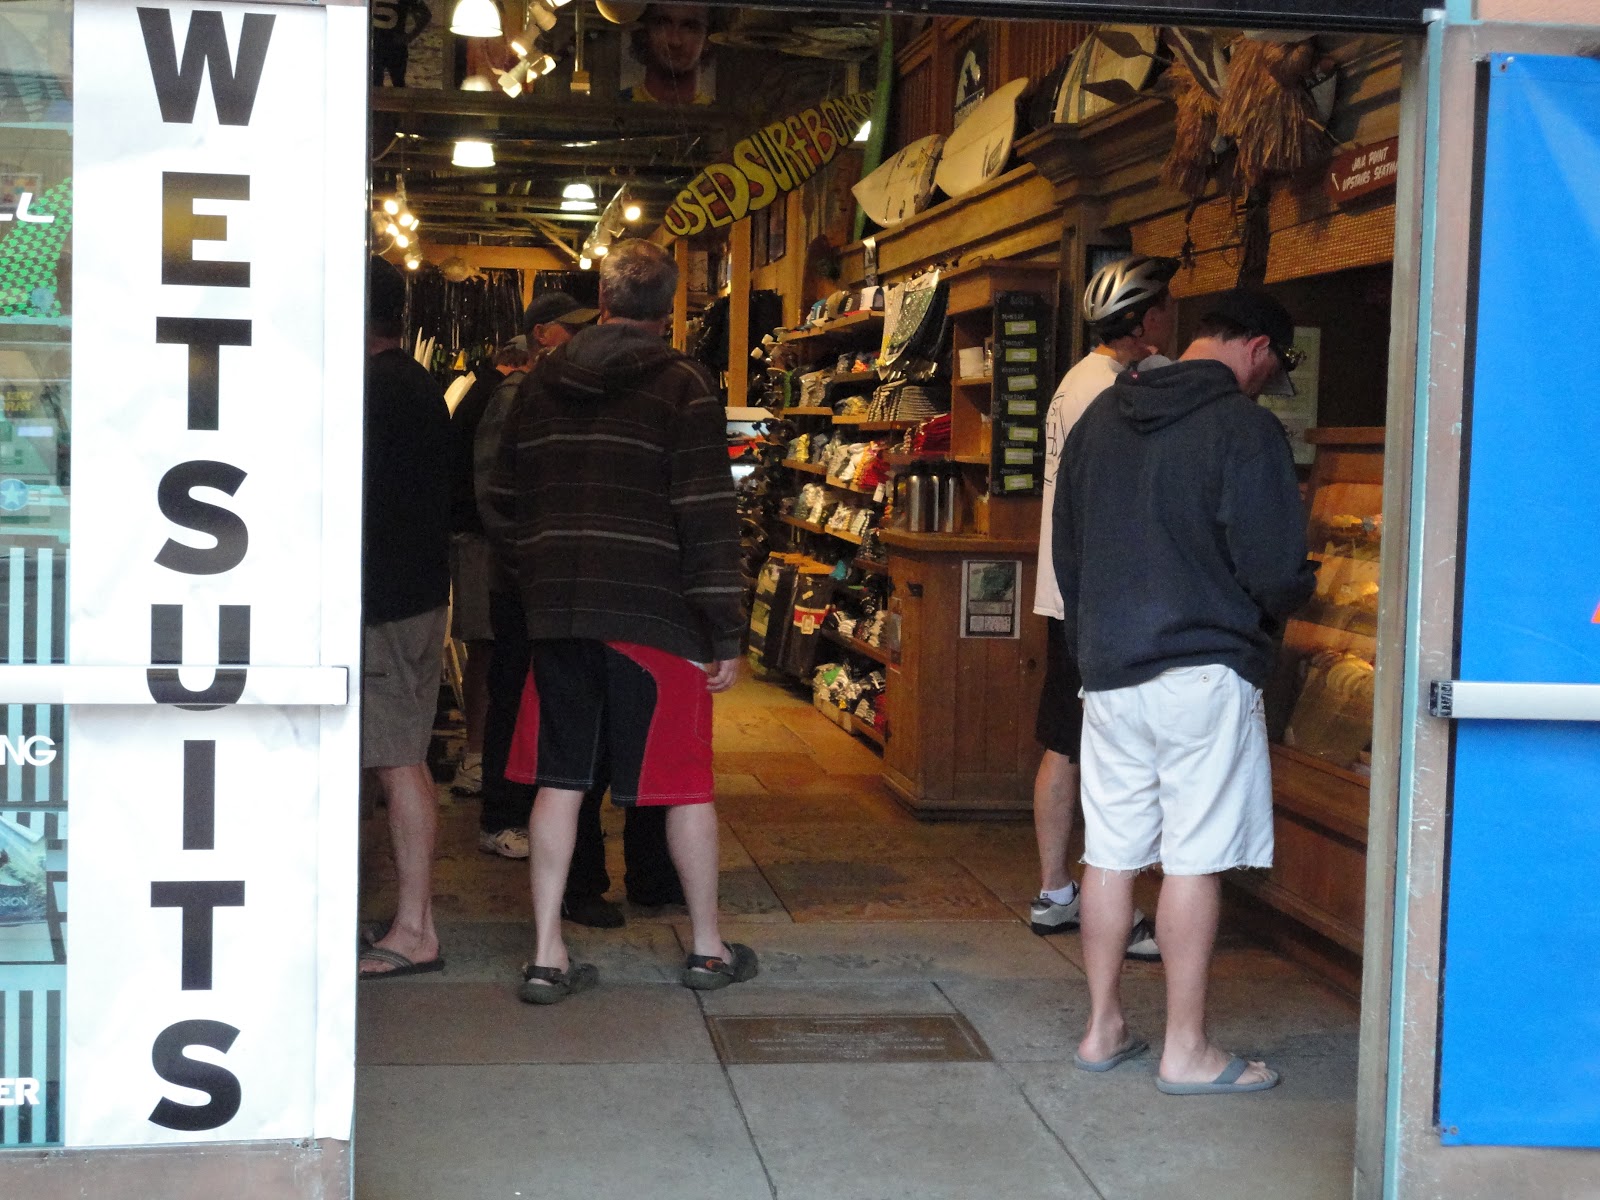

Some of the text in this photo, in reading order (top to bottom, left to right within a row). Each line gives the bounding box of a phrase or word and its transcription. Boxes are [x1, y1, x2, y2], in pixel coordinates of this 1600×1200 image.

[664, 163, 750, 236] USED
[1373, 161, 1398, 181] SEATIN
[136, 7, 276, 1132] WETSUITS
